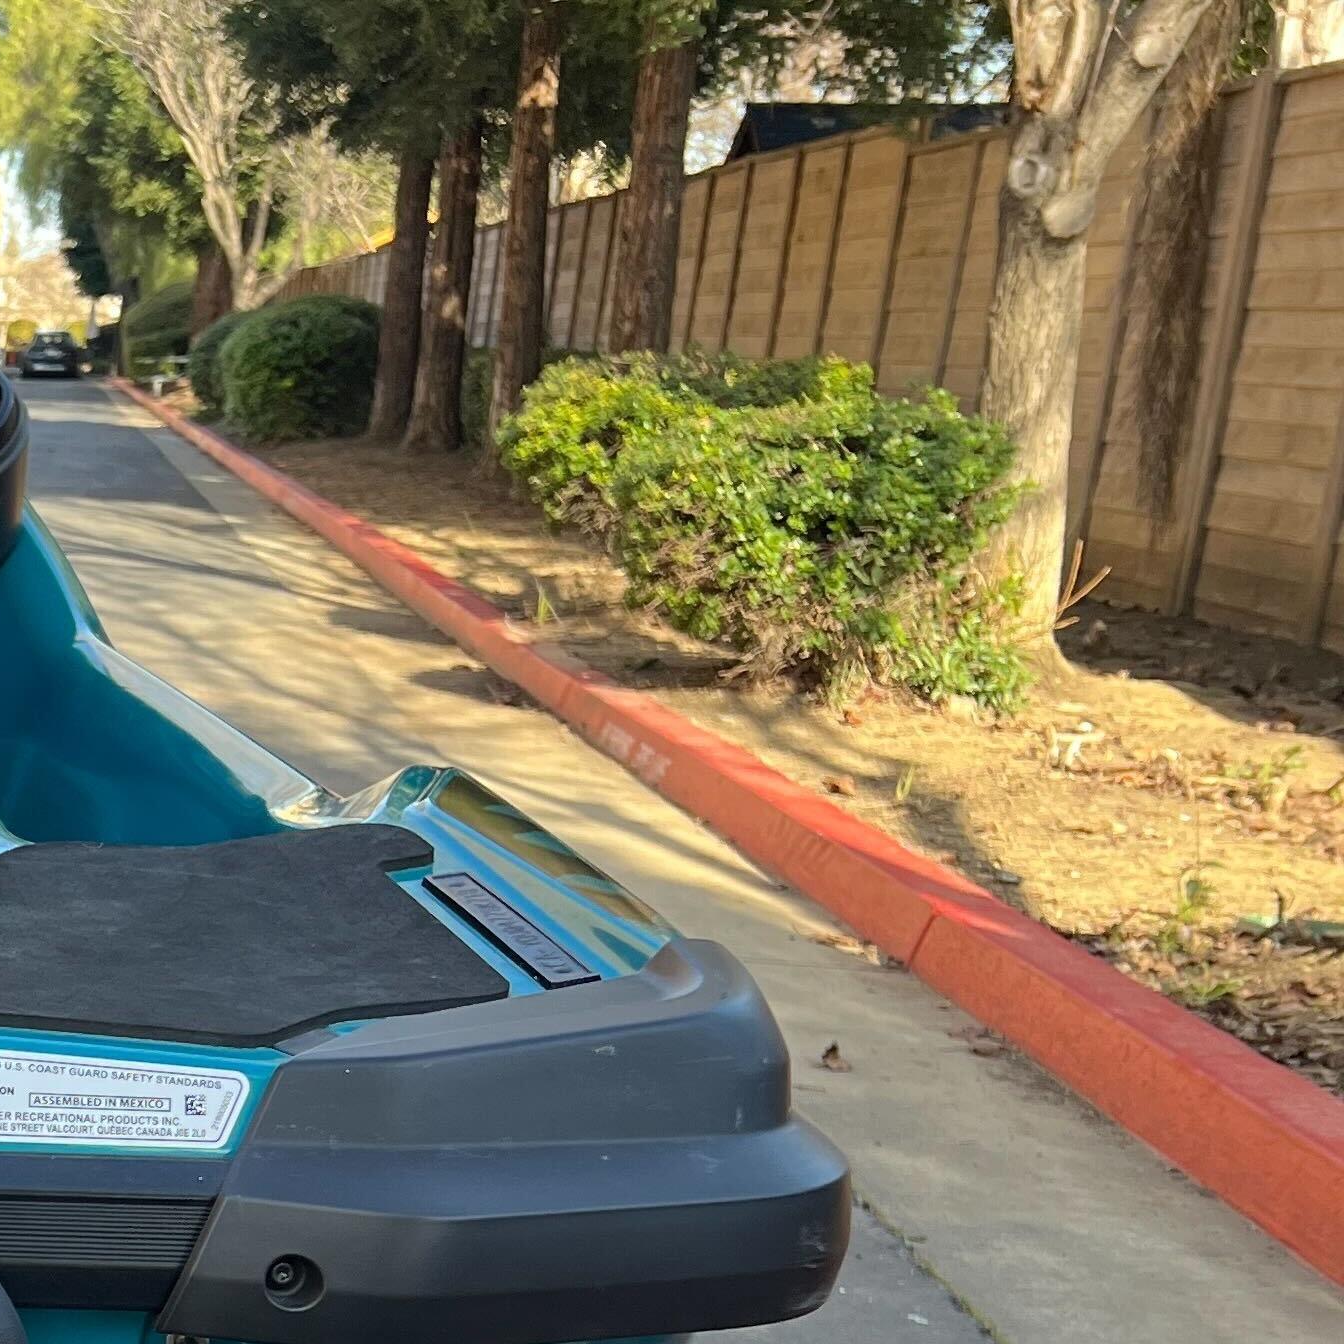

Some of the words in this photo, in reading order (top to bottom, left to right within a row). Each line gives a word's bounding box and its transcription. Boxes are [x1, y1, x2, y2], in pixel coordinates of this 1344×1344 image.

[4, 1062, 24, 1072] U.S.
[27, 1064, 66, 1076] COAST
[68, 1067, 108, 1079] GUARD
[110, 1071, 153, 1084] SAFETY
[155, 1075, 222, 1090] STANDARDS
[32, 1096, 102, 1107] ASSEMBLED
[104, 1099, 117, 1108] IN
[119, 1099, 164, 1109] MEXICO
[14, 1112, 97, 1124] RECREATIONAL
[99, 1115, 159, 1126] PRODUCTS
[10, 1123, 44, 1133] STREET
[135, 1128, 172, 1137] CANADA
